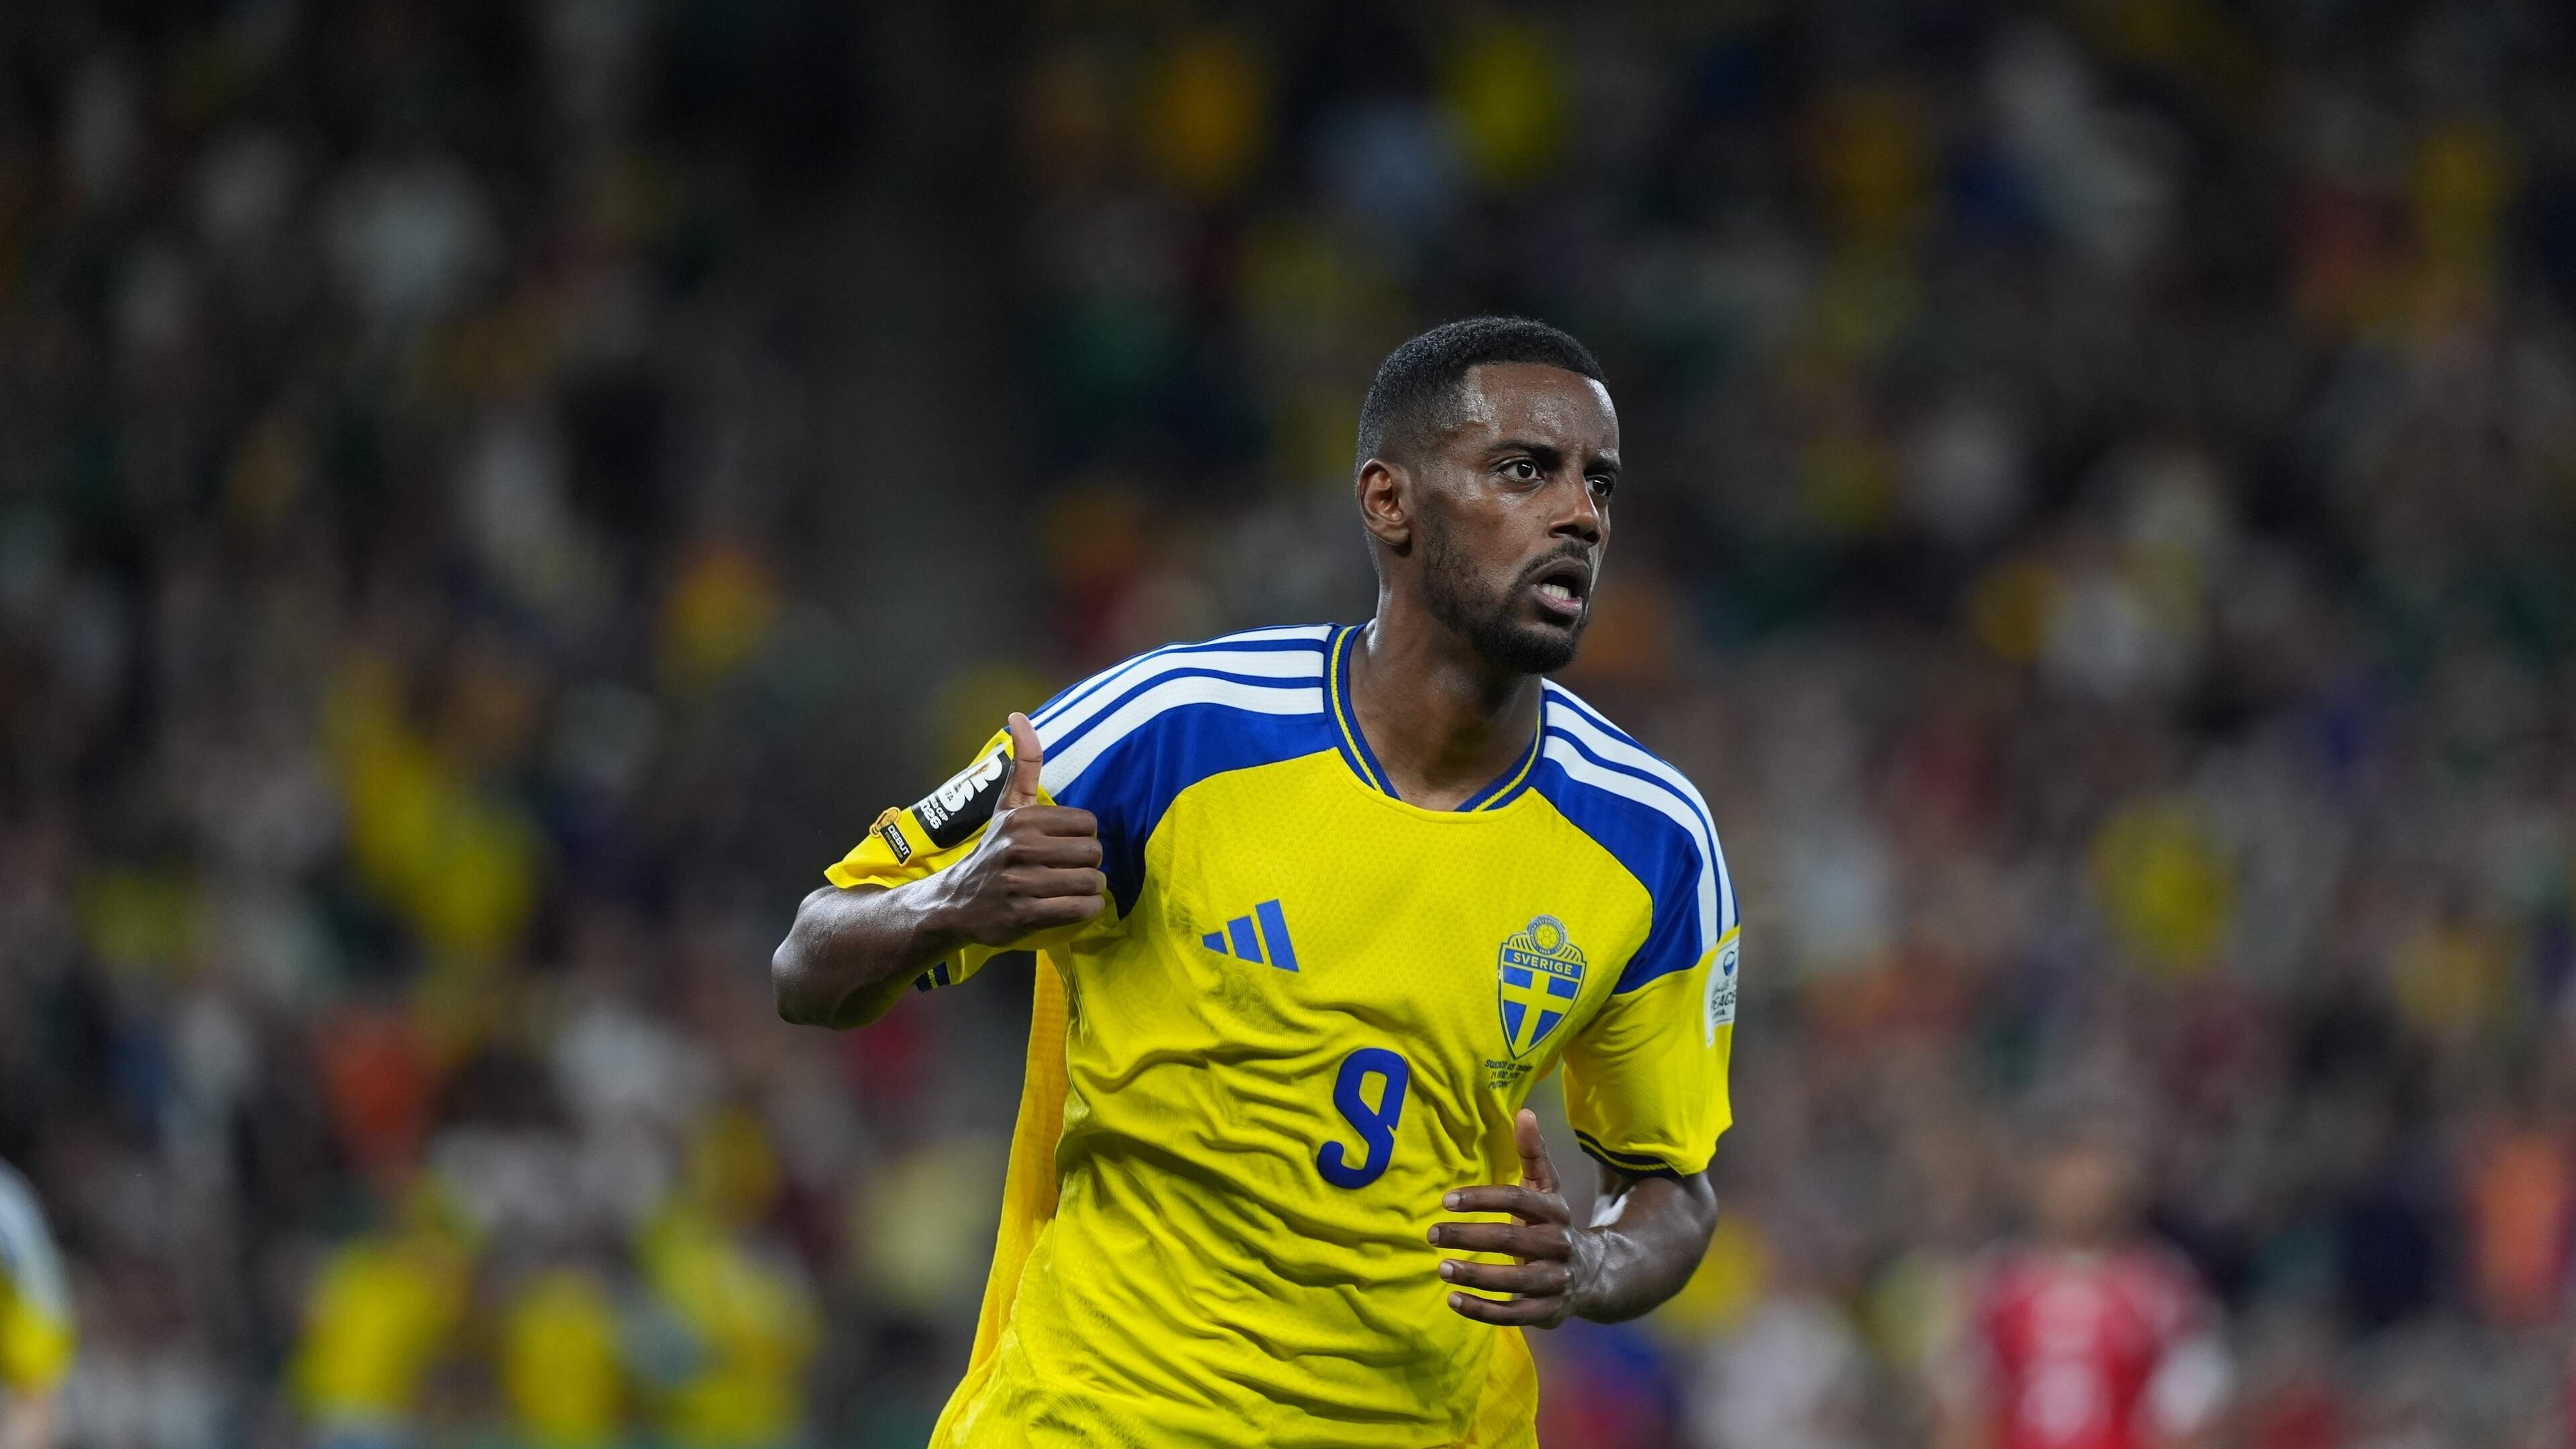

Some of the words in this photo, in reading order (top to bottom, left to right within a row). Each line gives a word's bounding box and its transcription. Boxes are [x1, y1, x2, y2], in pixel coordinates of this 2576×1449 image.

[920, 800, 942, 829] 026
[936, 807, 949, 821] CUP
[888, 824, 910, 855] DEBUT
[1513, 952, 1573, 975] SVERIGE
[1316, 1047, 1409, 1189] 9
